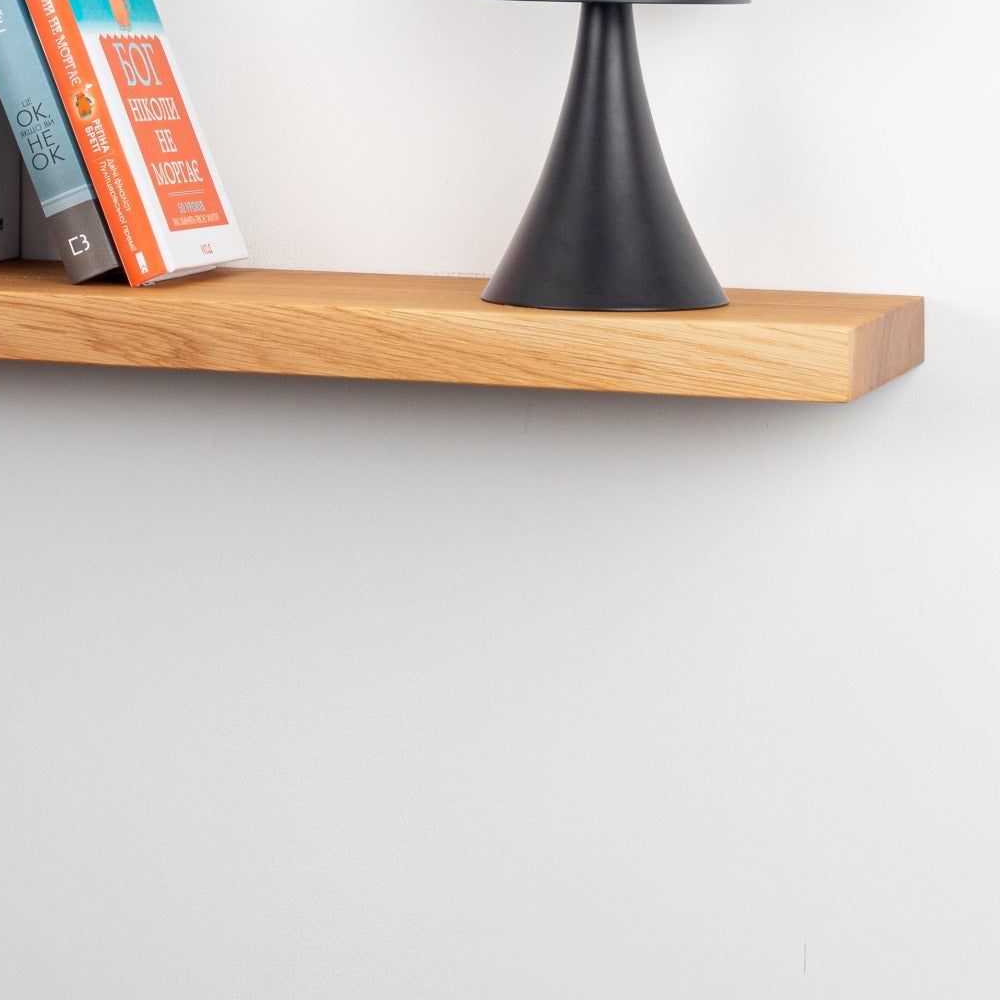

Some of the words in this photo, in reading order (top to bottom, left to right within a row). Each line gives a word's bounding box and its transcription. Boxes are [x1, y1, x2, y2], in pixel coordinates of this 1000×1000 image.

[48, 15, 63, 36] НЕ
[56, 35, 82, 86] МОРГАЄ
[113, 42, 163, 87] БОГ
[127, 97, 181, 122] НІКОЛИ
[27, 129, 56, 154] НЕ
[85, 126, 101, 153] БРЕТТ
[91, 118, 111, 154] РЕГІНА
[155, 129, 178, 153] НЕ
[151, 159, 204, 186] МОРГАЄ
